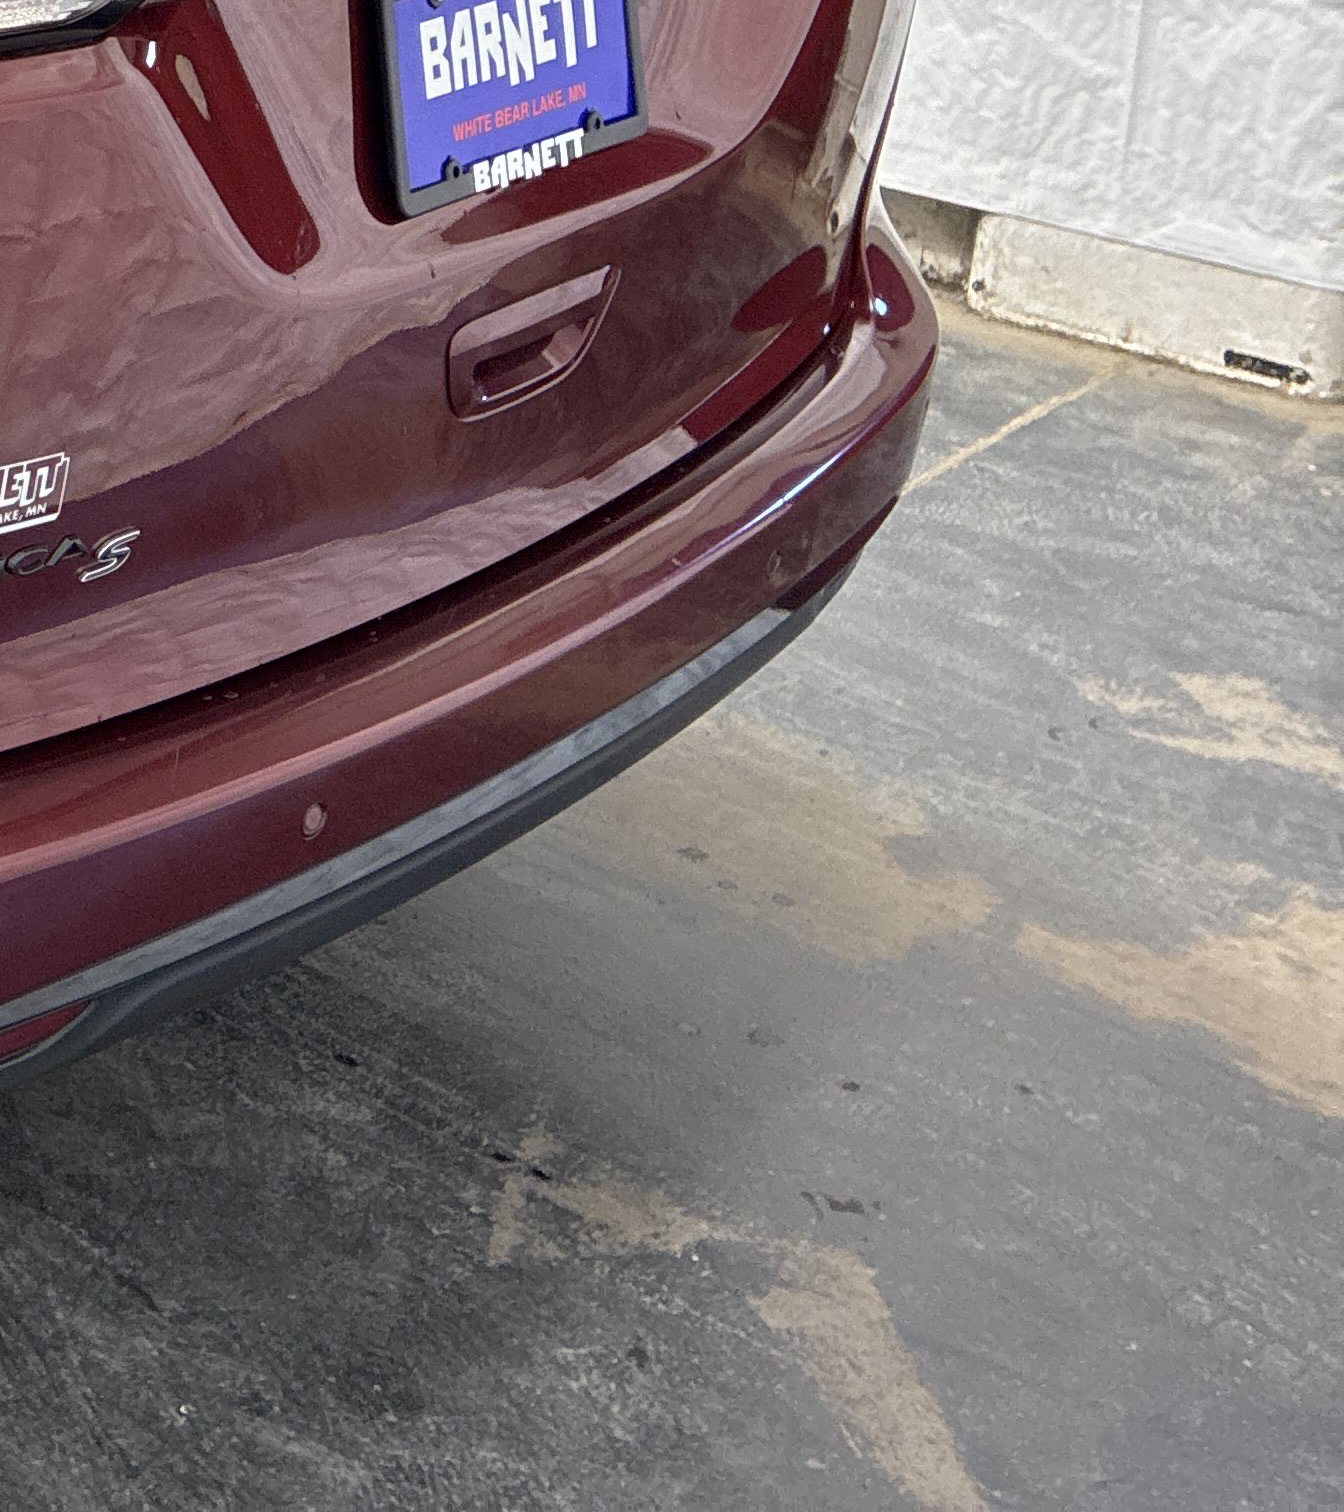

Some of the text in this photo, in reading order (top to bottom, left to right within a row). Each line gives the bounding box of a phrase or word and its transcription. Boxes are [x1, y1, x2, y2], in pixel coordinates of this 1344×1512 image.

[452, 113, 493, 142] WHITE
[495, 101, 530, 129] BEAR
[568, 81, 587, 103] MN
[473, 127, 585, 192] BARNETT
[25, 501, 48, 518] MN
[77, 525, 141, 583] S
